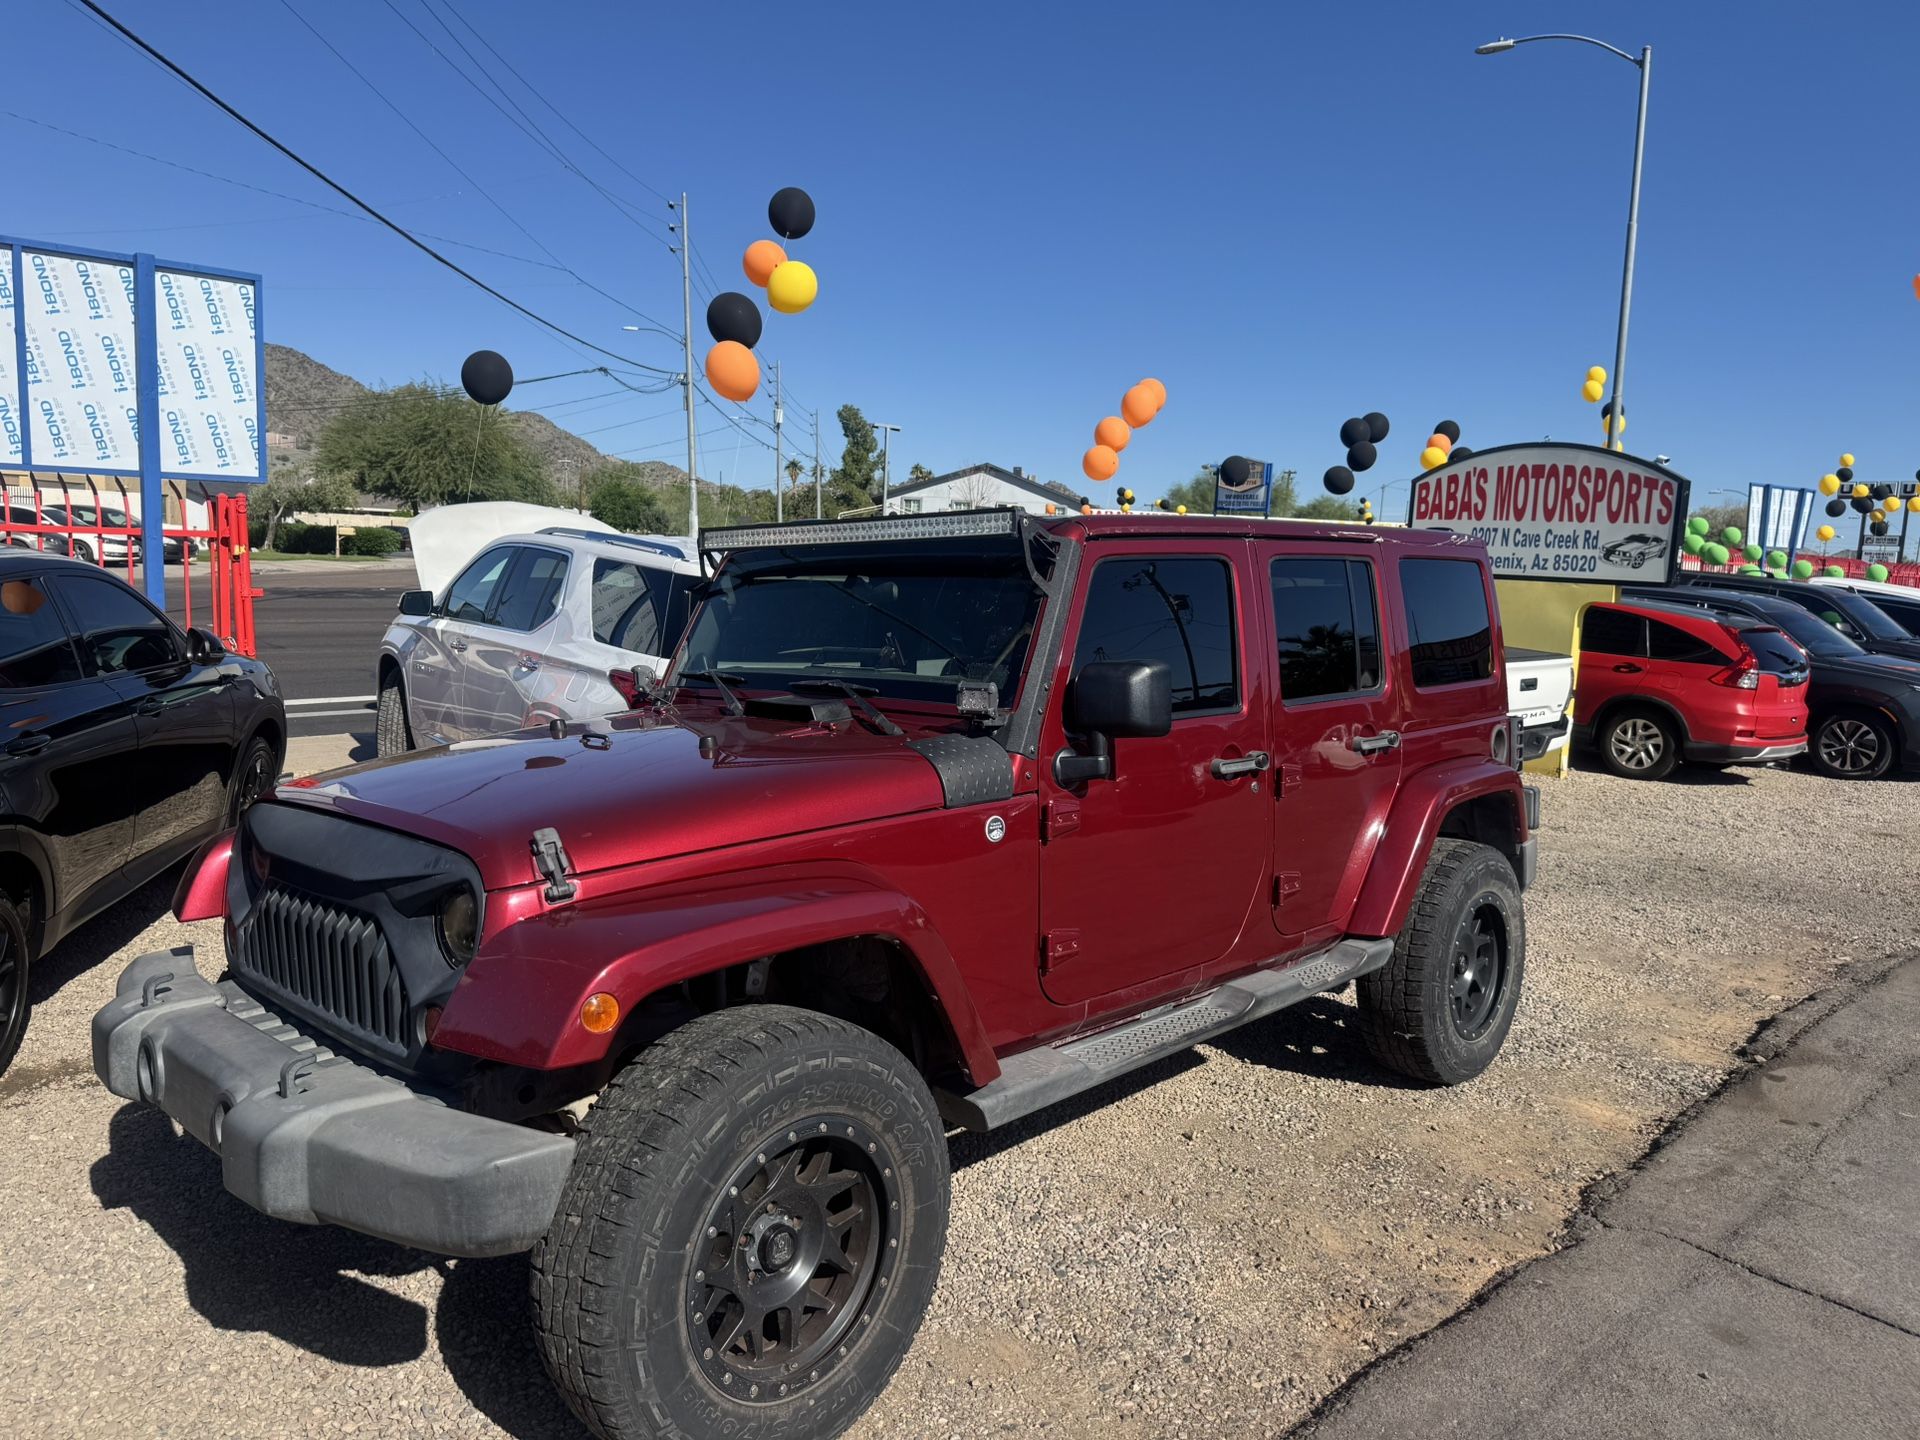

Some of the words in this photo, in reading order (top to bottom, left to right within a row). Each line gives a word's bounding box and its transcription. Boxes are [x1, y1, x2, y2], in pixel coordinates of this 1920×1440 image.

[1416, 467, 1488, 522] BABA'S
[1493, 463, 1675, 525] MOTORSPORTS
[1500, 527, 1510, 547] N
[1513, 528, 1541, 548] Cave
[1544, 528, 1580, 549] Creek
[1531, 553, 1549, 570] Az
[1553, 554, 1597, 572] 85020
[735, 1080, 897, 1151] CROSSWIND
